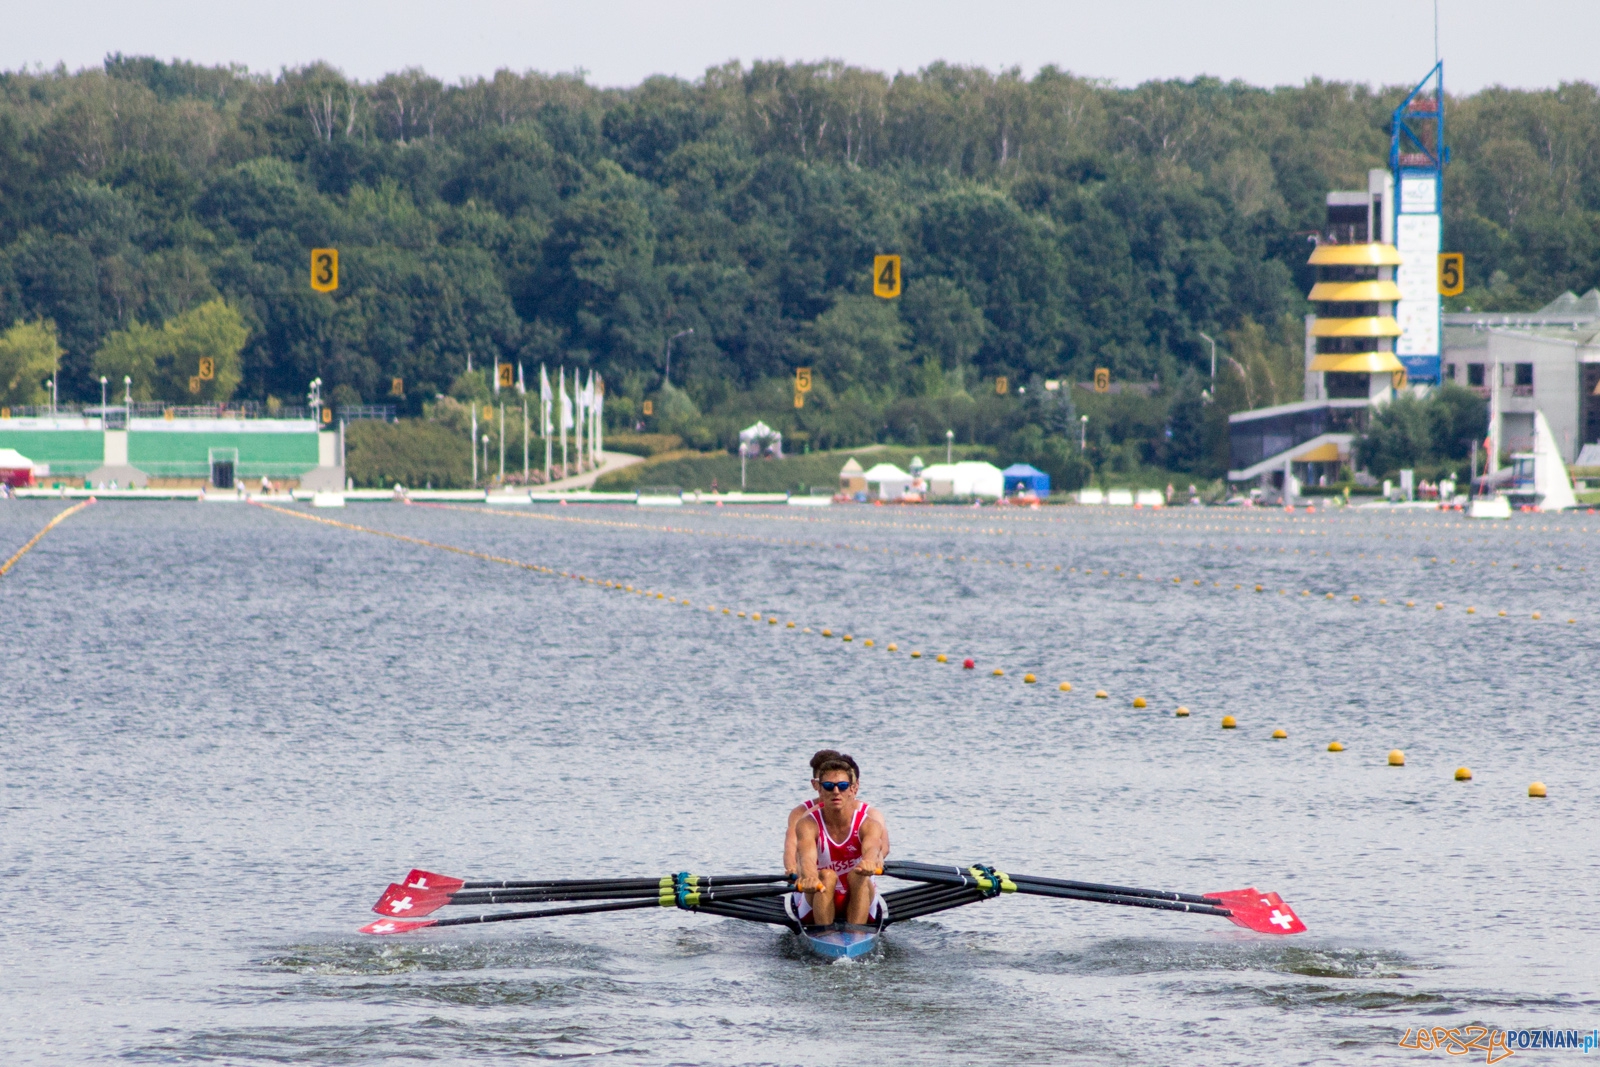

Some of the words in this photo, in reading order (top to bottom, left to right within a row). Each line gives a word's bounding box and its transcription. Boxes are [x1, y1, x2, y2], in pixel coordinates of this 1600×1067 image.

[317, 254, 333, 284] 3
[878, 260, 896, 290] 4
[1442, 258, 1459, 288] 5
[202, 360, 211, 377] 3
[500, 367, 511, 383] 4
[799, 371, 809, 388] 5
[1097, 372, 1107, 389] 6
[1395, 370, 1405, 387] 7
